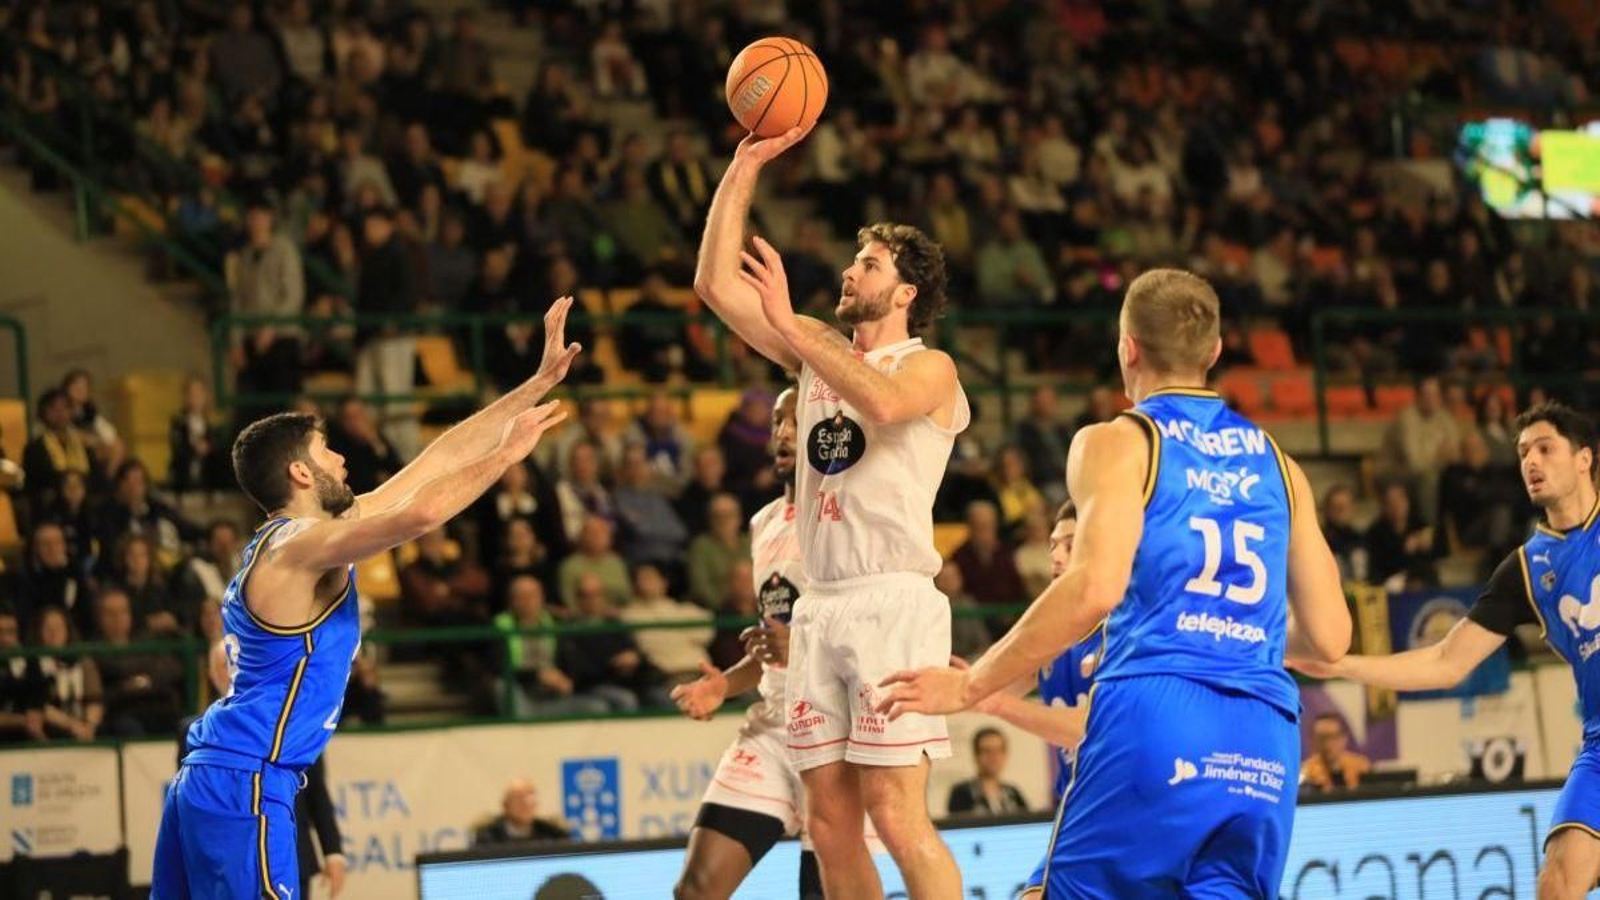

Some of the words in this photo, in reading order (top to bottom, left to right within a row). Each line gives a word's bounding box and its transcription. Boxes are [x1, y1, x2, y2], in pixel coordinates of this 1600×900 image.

[817, 490, 842, 522] 14
[1184, 516, 1267, 605] 15
[1176, 611, 1267, 644] telepizza
[788, 715, 826, 733] UNDAI
[1202, 763, 1259, 785] Jiménez
[1260, 770, 1285, 791] Díaz
[1233, 753, 1286, 776] Fundación
